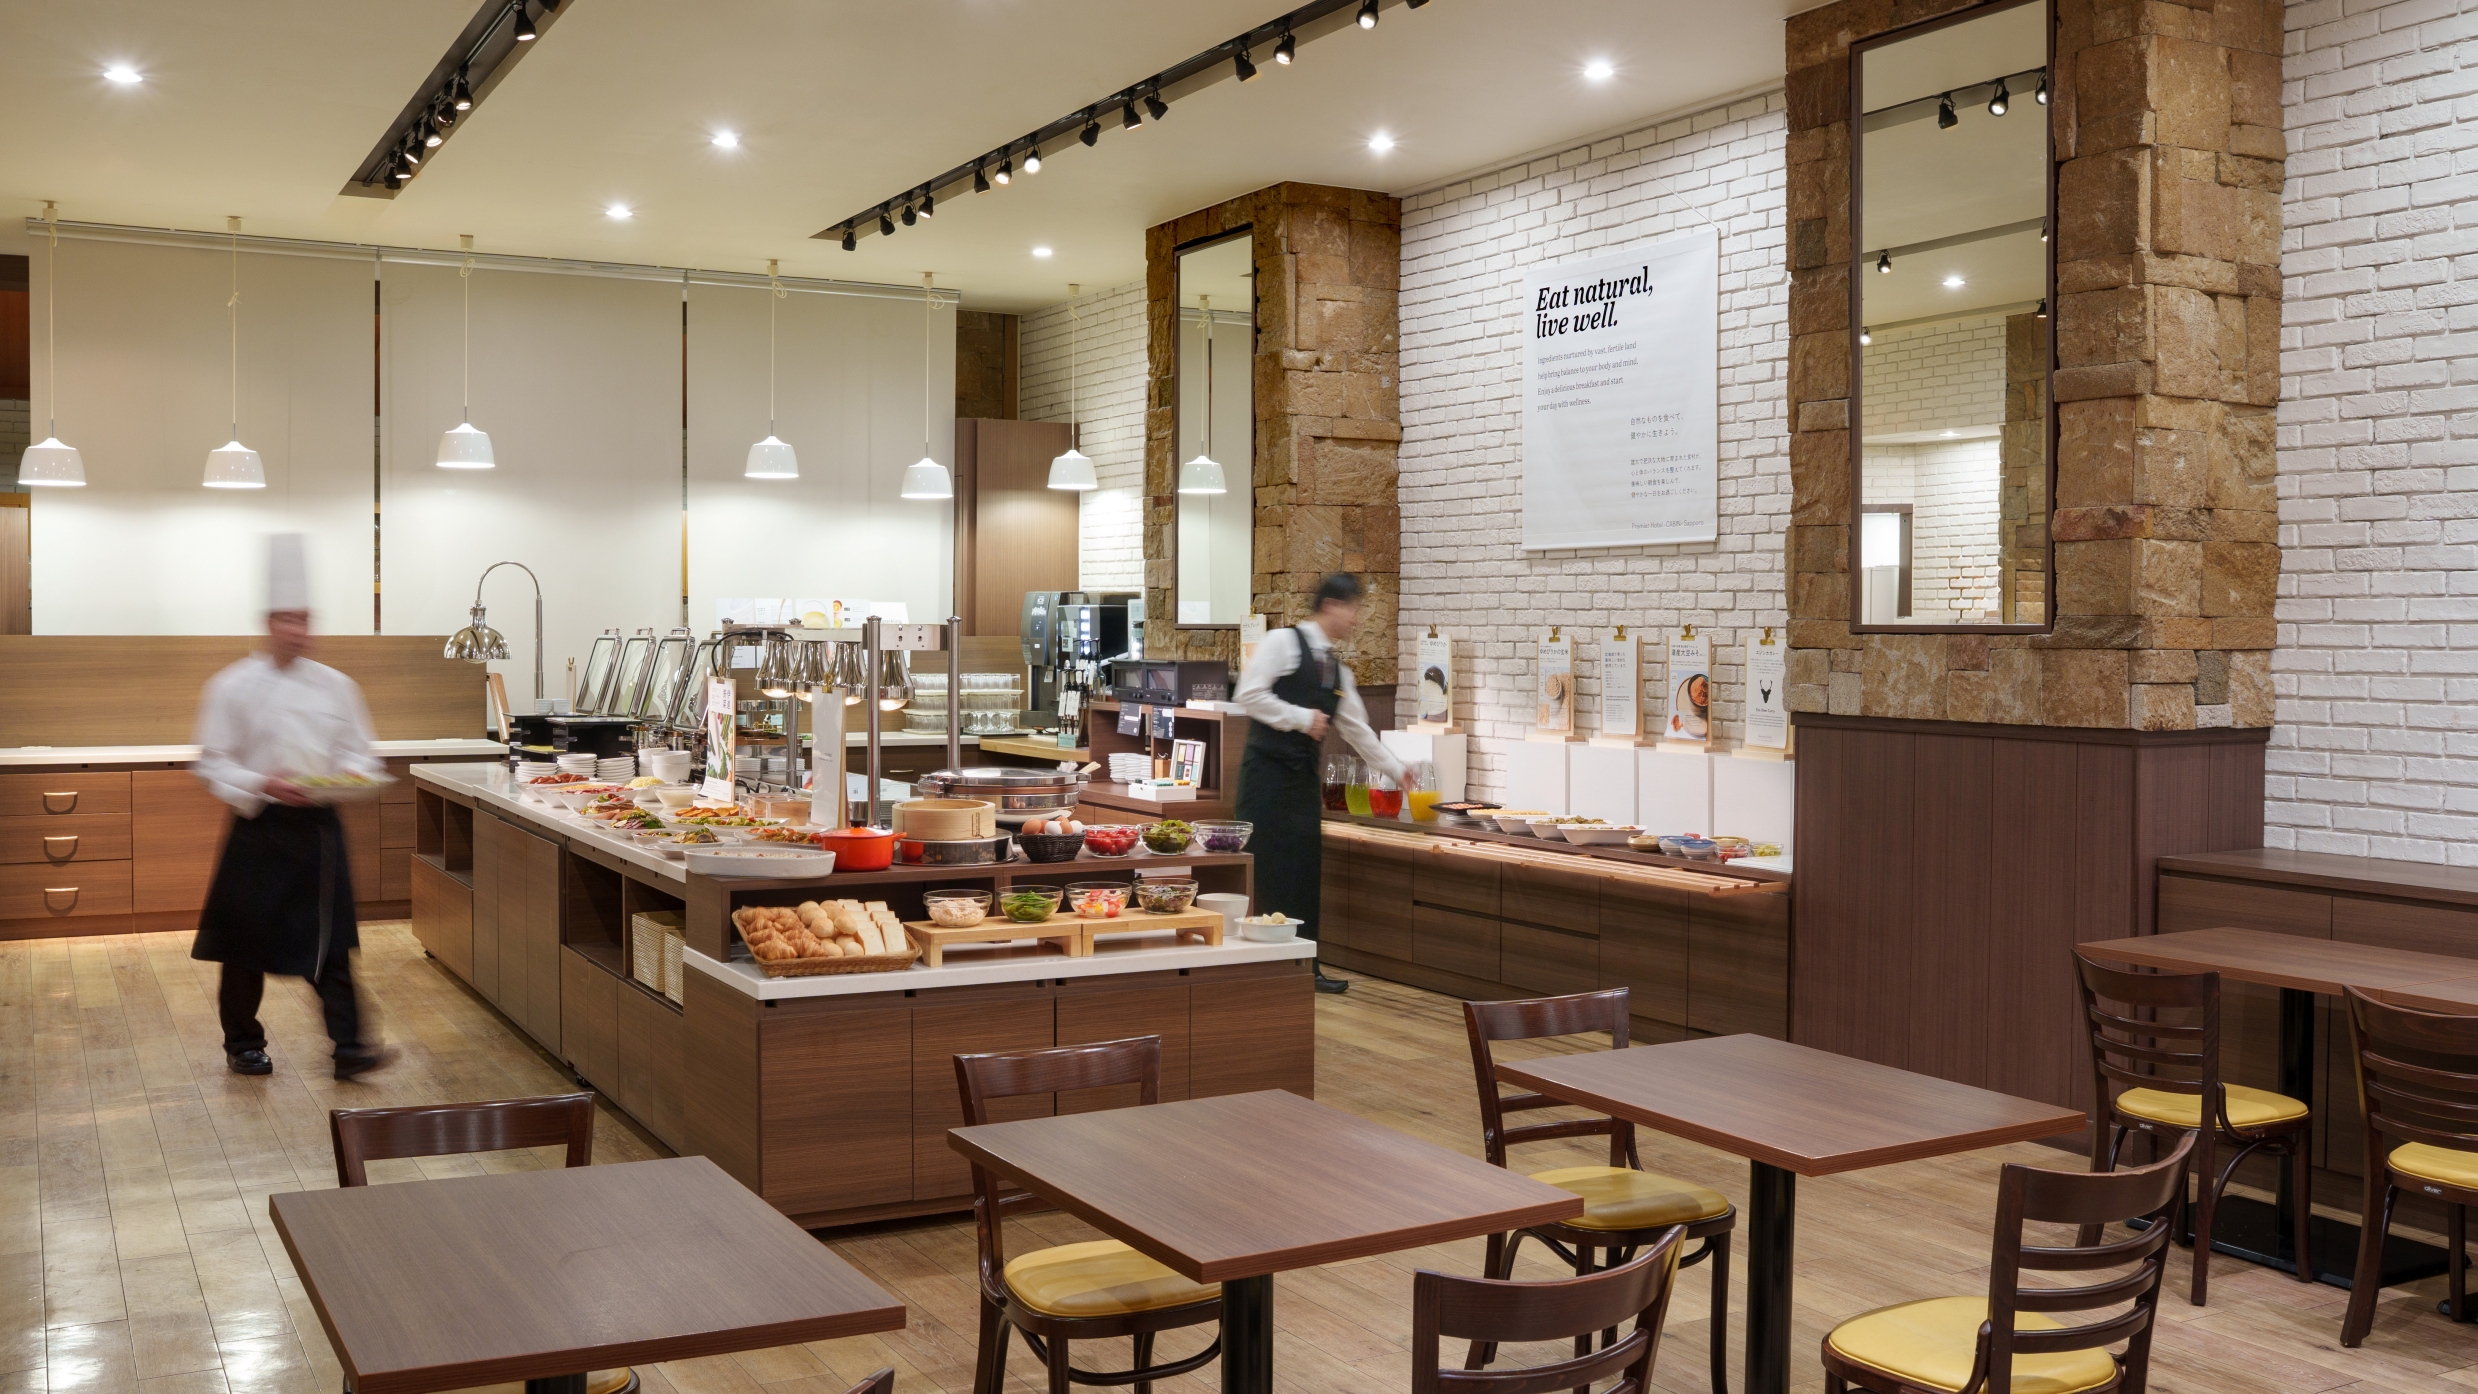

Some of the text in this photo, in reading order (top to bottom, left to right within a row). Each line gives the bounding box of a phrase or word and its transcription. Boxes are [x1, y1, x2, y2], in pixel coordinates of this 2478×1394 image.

[1536, 266, 1653, 311] Eat natural,
[1537, 301, 1618, 339] live well.
[1538, 354, 1563, 365] Ingredients
[1564, 349, 1586, 360] nurtured
[1587, 348, 1594, 357] by
[1608, 343, 1624, 353] fertile
[1625, 341, 1636, 350] land
[1538, 372, 1547, 380] help
[1548, 370, 1560, 378] bring
[1561, 367, 1579, 376] balance
[1586, 365, 1597, 374] your
[1599, 361, 1611, 371] body
[1612, 360, 1622, 368] and
[1623, 357, 1638, 366] mind.
[1538, 388, 1550, 396] Enjoy
[1554, 384, 1575, 393] delicious
[1576, 380, 1599, 390] breakfast
[1600, 378, 1610, 386] and
[1537, 404, 1549, 412] your
[1558, 400, 1568, 408] with
[1630, 413, 1683, 426] 自然なものを食べて、
[1630, 428, 1678, 440] 健やかに生きよう。
